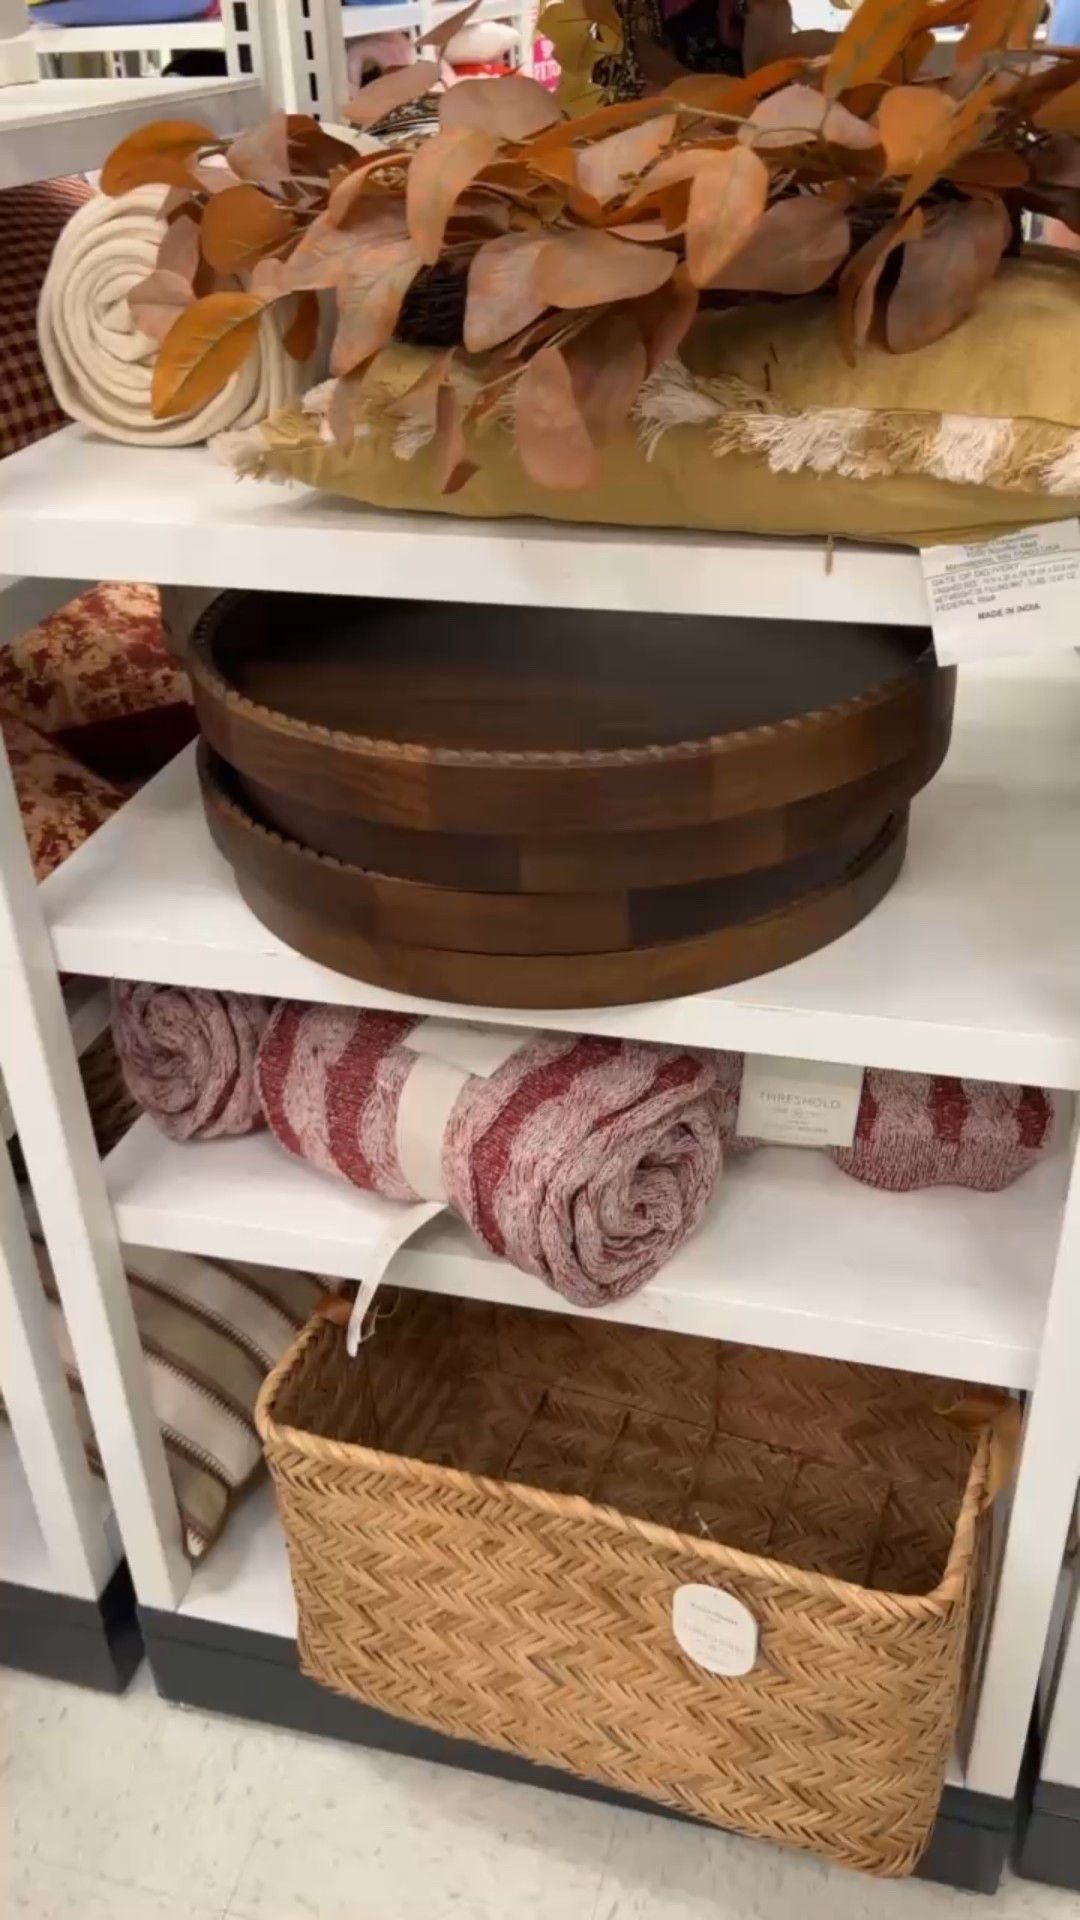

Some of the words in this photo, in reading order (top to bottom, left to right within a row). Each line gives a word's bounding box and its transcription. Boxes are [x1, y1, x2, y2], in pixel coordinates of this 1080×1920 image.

[931, 576, 956, 588] DATE
[958, 571, 971, 581] OF
[974, 563, 1020, 578] DELIVERY
[936, 599, 975, 612] FEDERAL
[978, 609, 1003, 620] MADE
[1005, 607, 1015, 615] IN
[1016, 603, 1040, 614] INDIA
[760, 1091, 841, 1110] THRESHOLD
